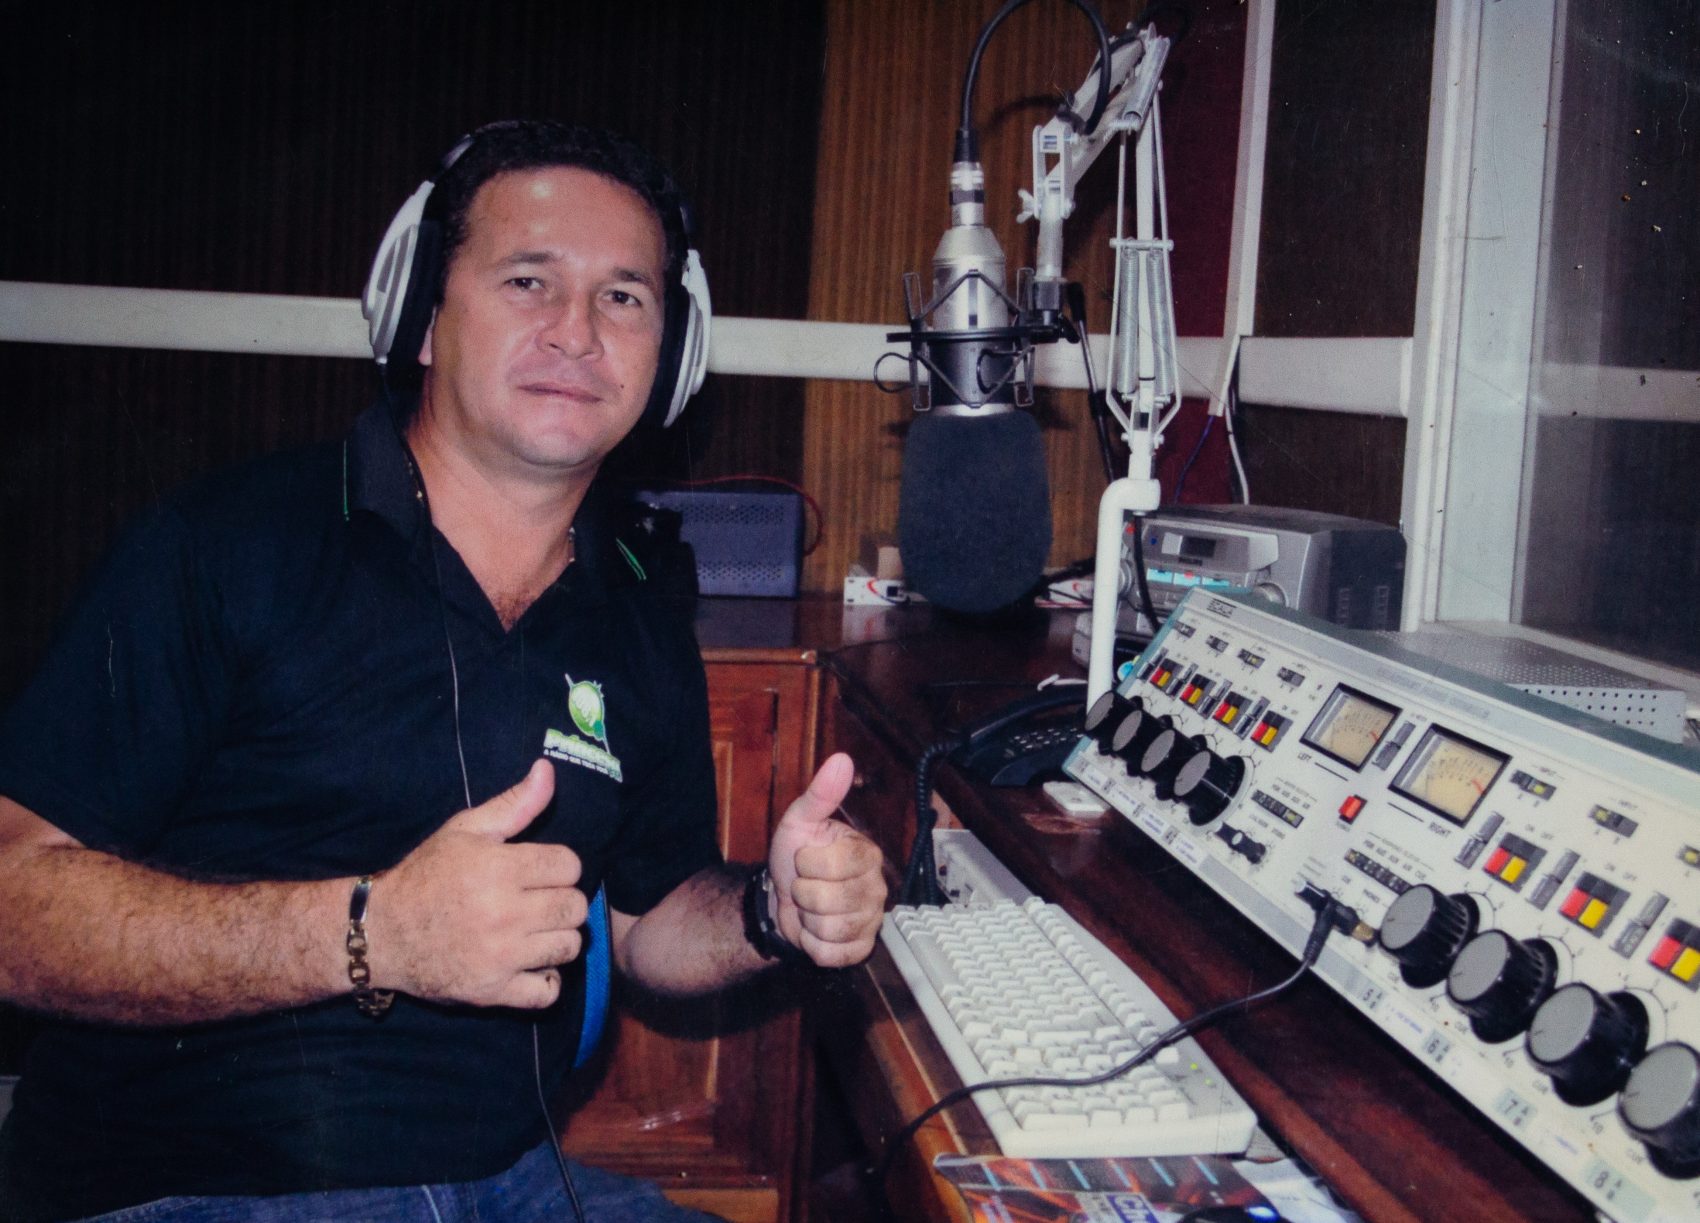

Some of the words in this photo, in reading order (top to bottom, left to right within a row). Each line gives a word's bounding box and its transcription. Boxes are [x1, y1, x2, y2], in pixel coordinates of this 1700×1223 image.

[1297, 751, 1312, 763] LEFT
[1429, 821, 1452, 838] RIGHT
[1504, 1098, 1518, 1115] 7
[1594, 1170, 1609, 1189] 8
